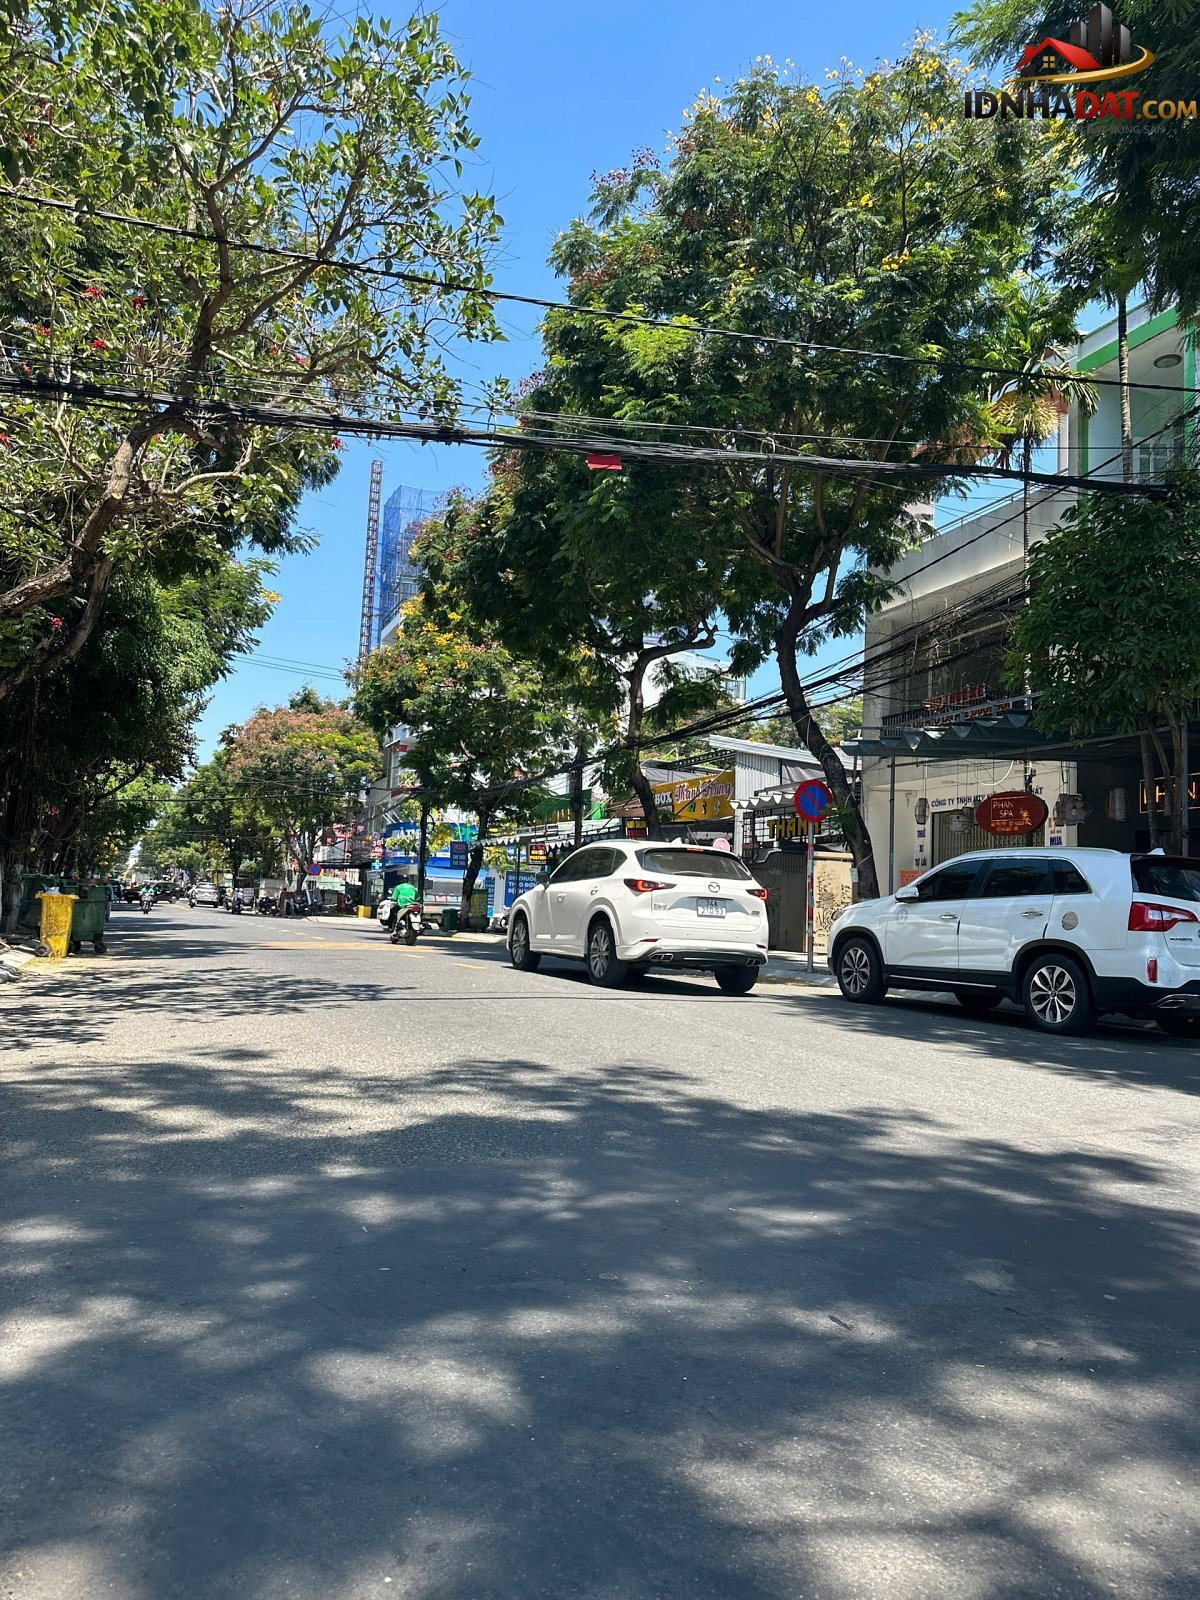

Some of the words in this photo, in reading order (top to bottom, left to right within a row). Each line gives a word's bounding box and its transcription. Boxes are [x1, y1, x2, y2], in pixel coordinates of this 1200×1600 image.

[948, 798, 955, 806] TY
[1000, 810, 1014, 818] SPA
[1050, 836, 1062, 846] MUA
